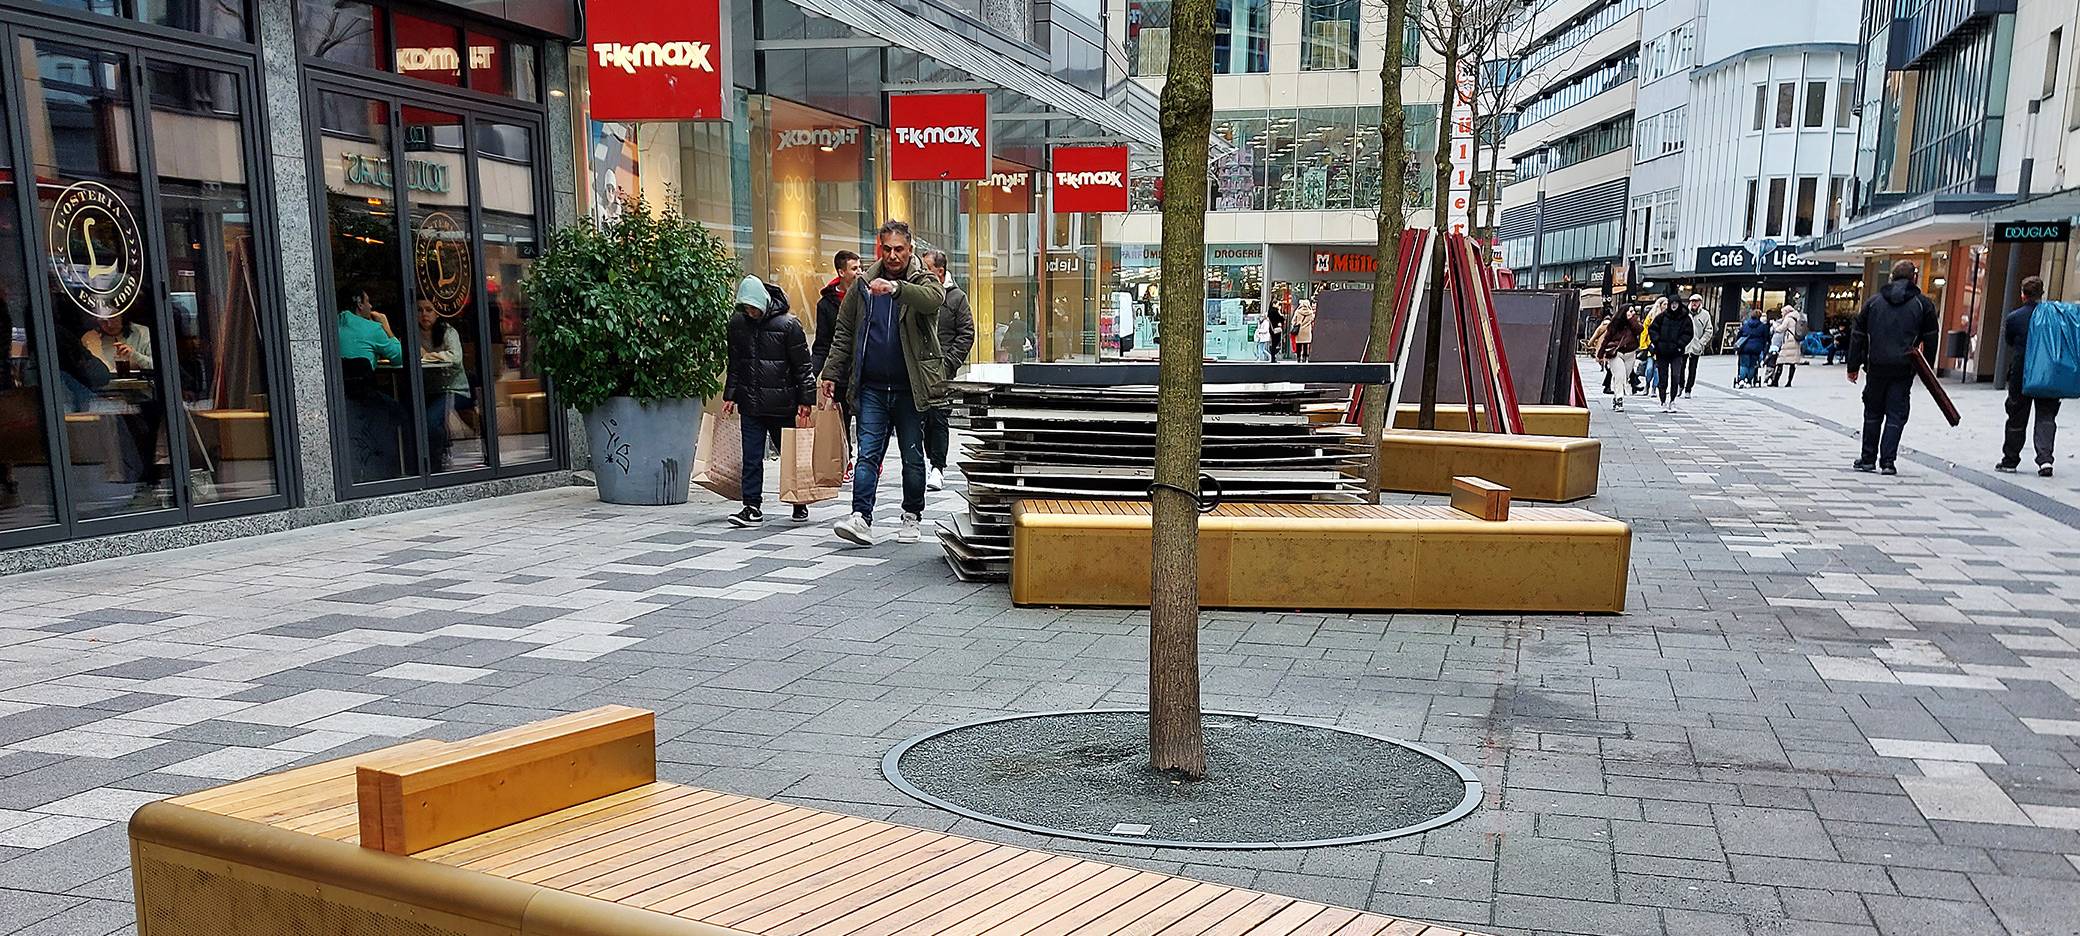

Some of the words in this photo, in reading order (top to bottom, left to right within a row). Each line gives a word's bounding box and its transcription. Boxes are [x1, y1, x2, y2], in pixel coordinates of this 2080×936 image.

[2005, 226, 2059, 238] DOUGLAS
[1214, 249, 1263, 258] DROGERIE
[1711, 250, 1744, 267] Café
